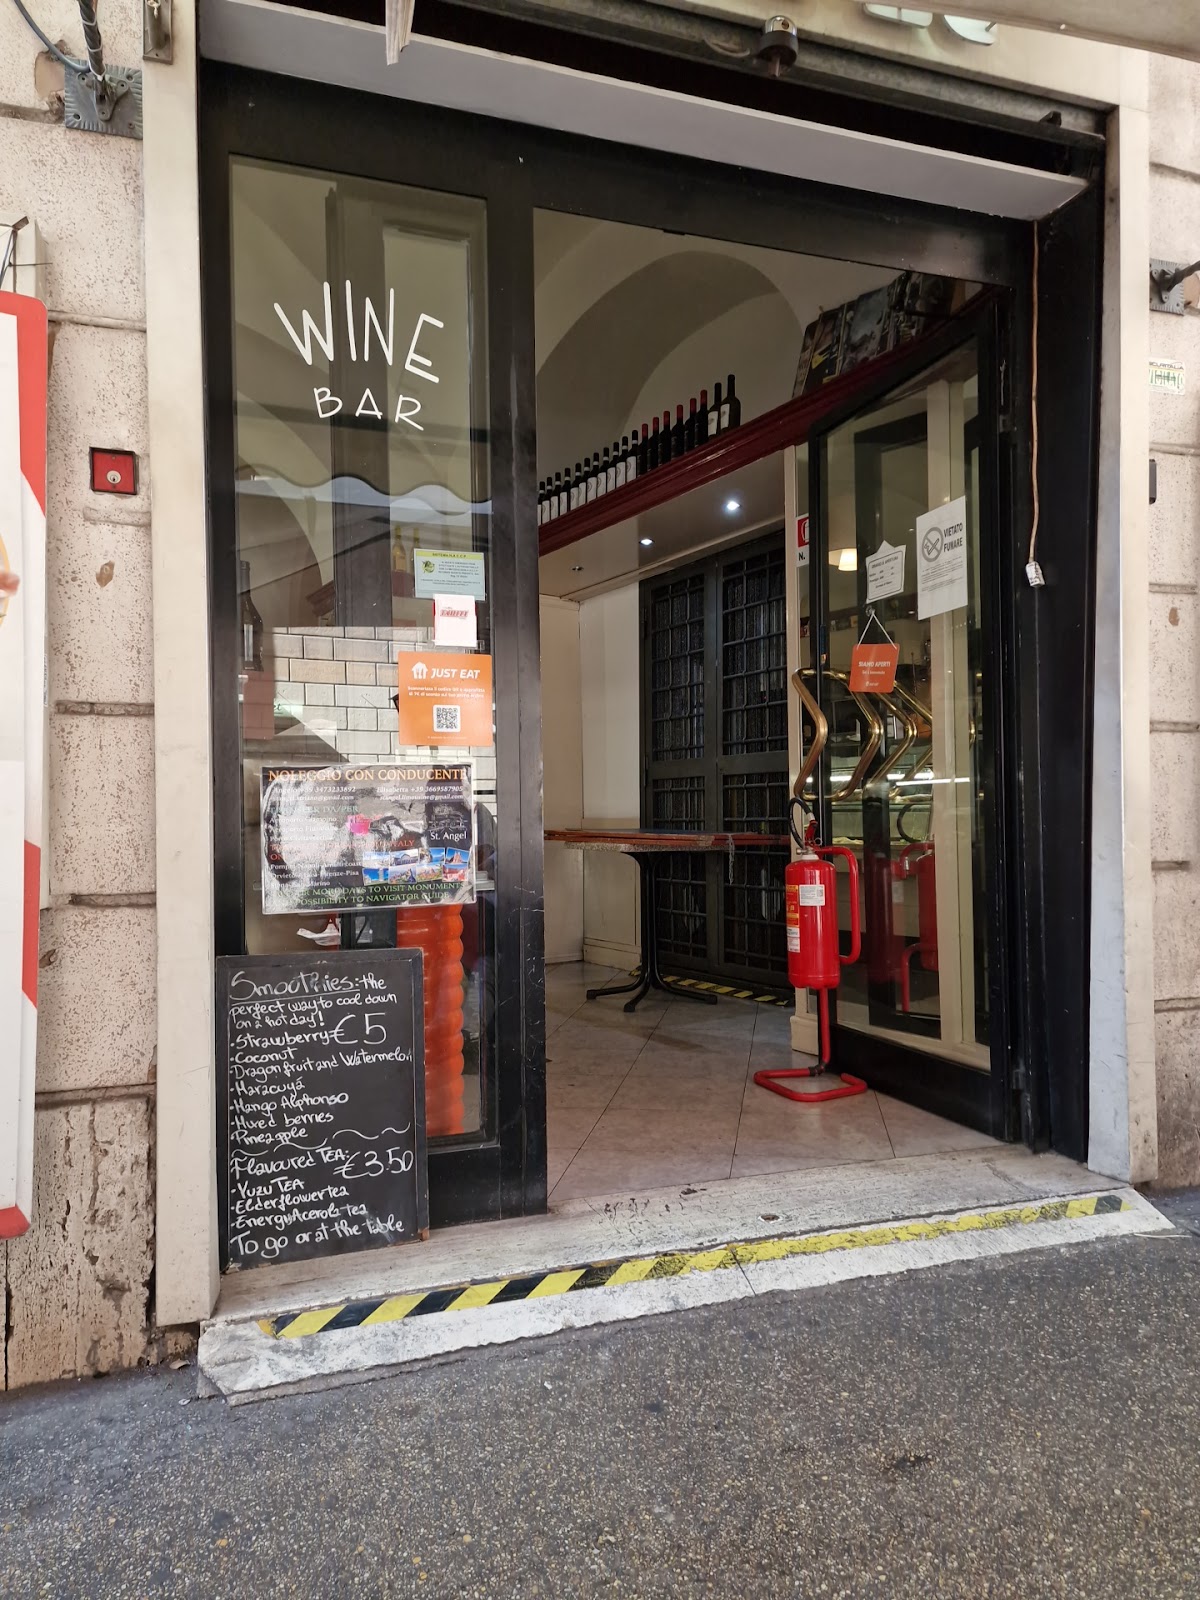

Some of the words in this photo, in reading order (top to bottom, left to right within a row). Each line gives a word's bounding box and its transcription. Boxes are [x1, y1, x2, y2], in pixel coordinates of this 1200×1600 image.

[273, 279, 444, 383] WINE
[313, 386, 424, 431] BAR
[943, 522, 963, 538] VIETATO
[943, 537, 963, 552] FUMARE
[431, 668, 458, 679] JUST
[460, 669, 481, 679] EAT
[268, 769, 341, 781] NOLEGGIO
[345, 769, 374, 781] CON
[378, 768, 466, 780] CONDUCENTE
[430, 832, 440, 840] St.
[443, 832, 467, 843] Angel
[383, 884, 405, 892] VISIT
[407, 882, 464, 891] MONUMENTS
[366, 893, 419, 901] NAVIGATOR
[359, 972, 387, 989] the
[229, 1000, 285, 1023] perfect
[288, 1000, 318, 1015] way
[317, 996, 333, 1009] to
[336, 993, 362, 1005] cool
[365, 993, 397, 1004] down
[236, 1020, 252, 1029] on
[255, 1020, 262, 1029] a
[265, 1013, 288, 1027] hot
[289, 1011, 325, 1028] day!
[236, 1031, 329, 1049] Strawberry
[235, 1046, 298, 1063] Coconut
[231, 1064, 281, 1083] Dragon
[283, 1057, 314, 1077] fruit
[315, 1055, 339, 1072] and
[339, 1046, 412, 1066] Watermelon
[235, 1076, 306, 1099] Maracuyá
[233, 1098, 277, 1116] Mango
[281, 1092, 349, 1112] Alphonso
[235, 1113, 277, 1130] Mixed
[284, 1112, 335, 1127] berries
[231, 1126, 309, 1145] Pineapple
[230, 1150, 316, 1180] Flavoured
[332, 1146, 414, 1179] €3.50
[237, 1180, 273, 1199] Yuzu
[270, 1176, 305, 1192] TEA
[235, 1191, 324, 1214] Elderflower
[321, 1185, 350, 1198] tea
[291, 1202, 342, 1222] Acerola
[340, 1203, 369, 1217] tea
[229, 1230, 259, 1255] To
[260, 1236, 289, 1258] go
[295, 1231, 312, 1244] or
[315, 1222, 329, 1243] at
[330, 1219, 362, 1238] the
[361, 1213, 405, 1234] table
